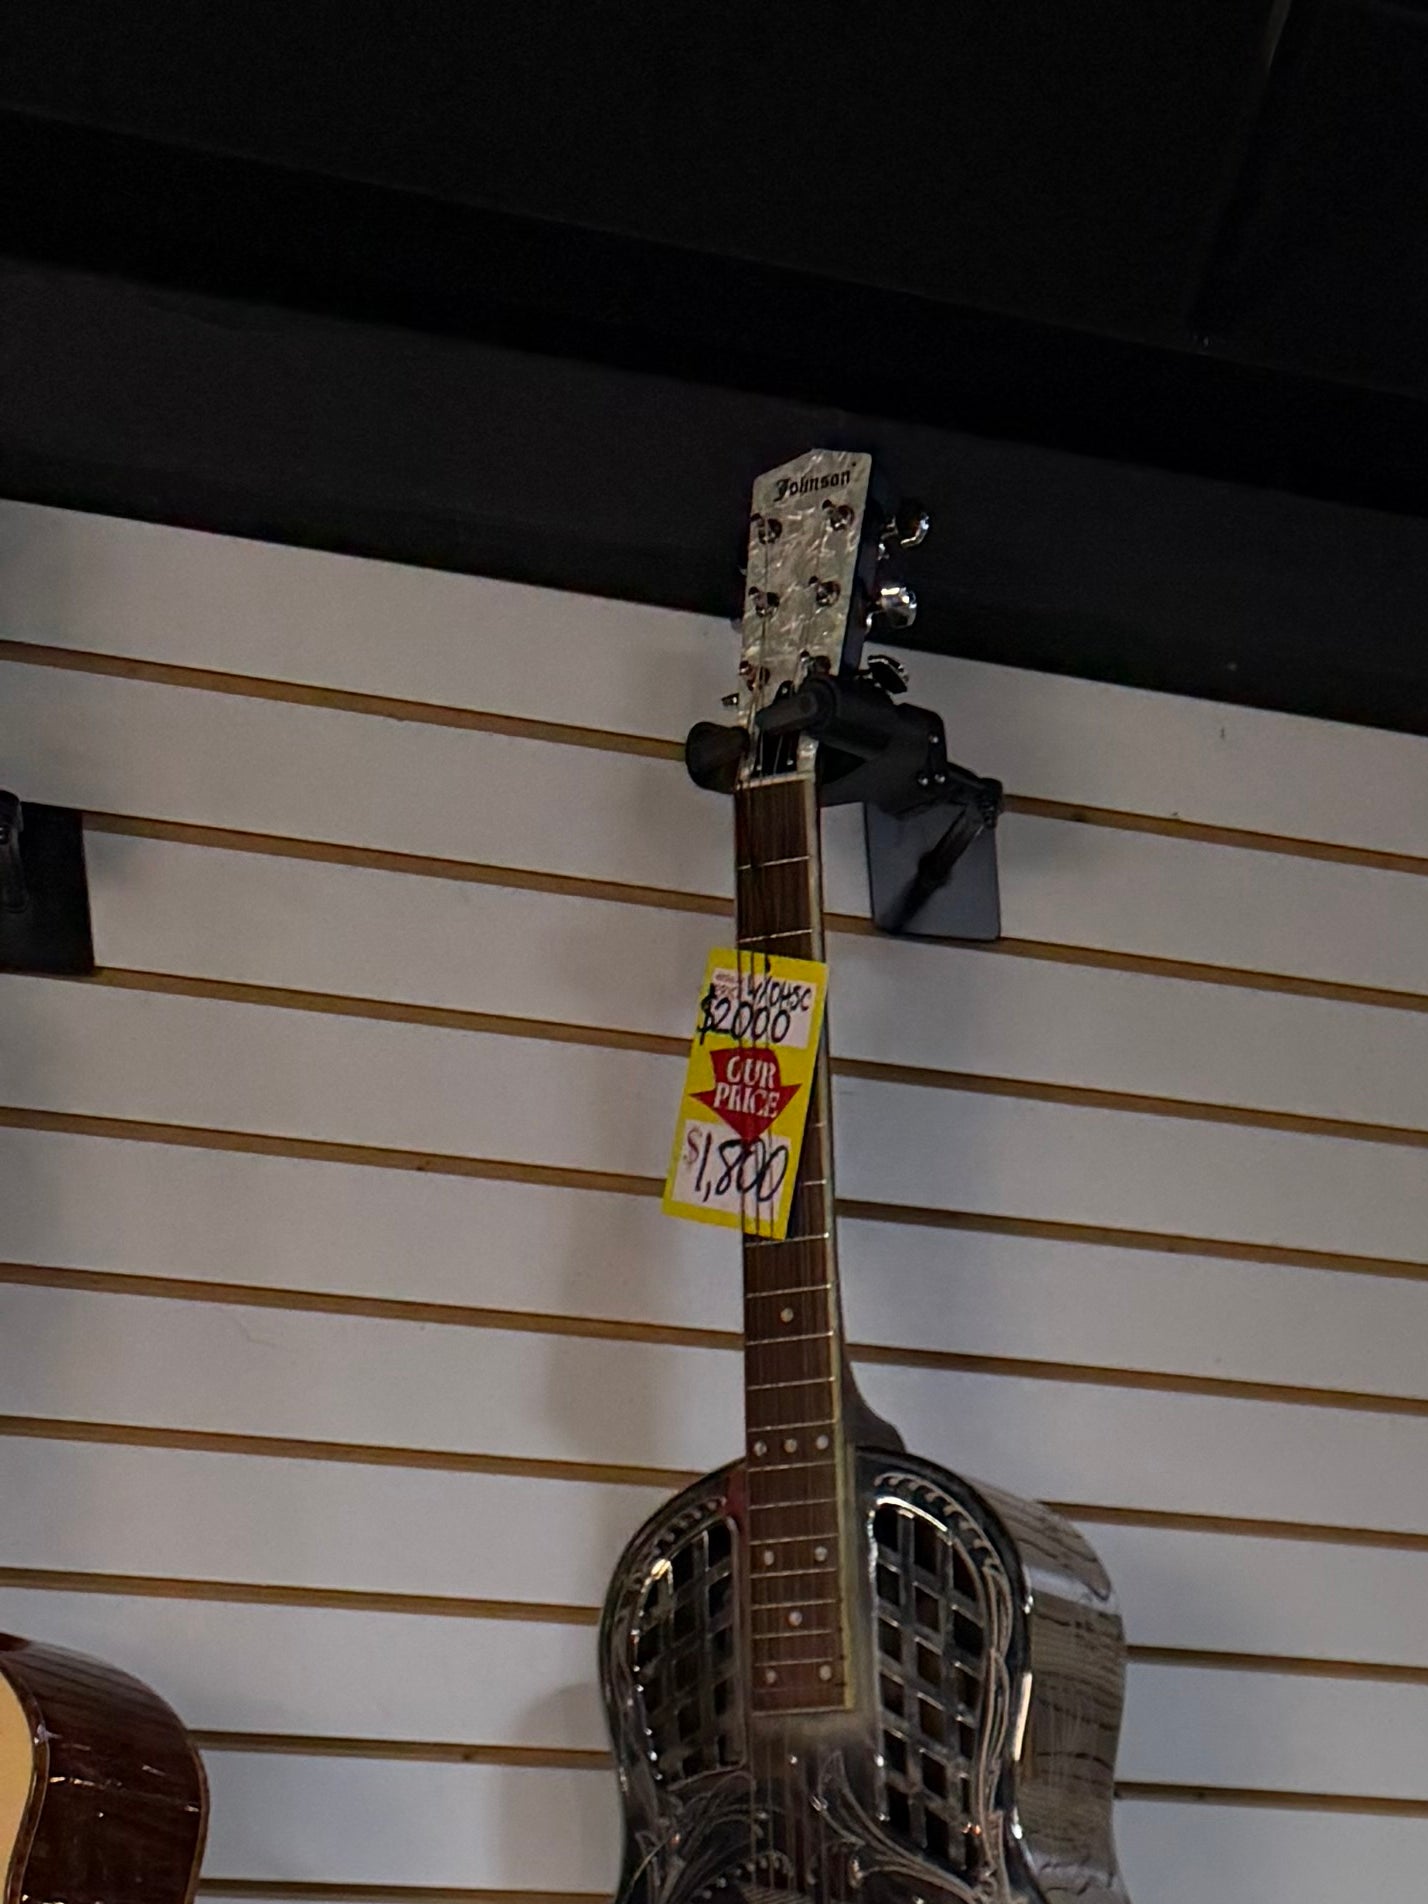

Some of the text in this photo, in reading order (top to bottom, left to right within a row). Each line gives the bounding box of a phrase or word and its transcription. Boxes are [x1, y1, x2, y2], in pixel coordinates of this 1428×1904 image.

[774, 470, 850, 502] Johnson
[697, 983, 790, 1045] $2000
[726, 1056, 775, 1086] OUR
[713, 1083, 780, 1119] PRICE
